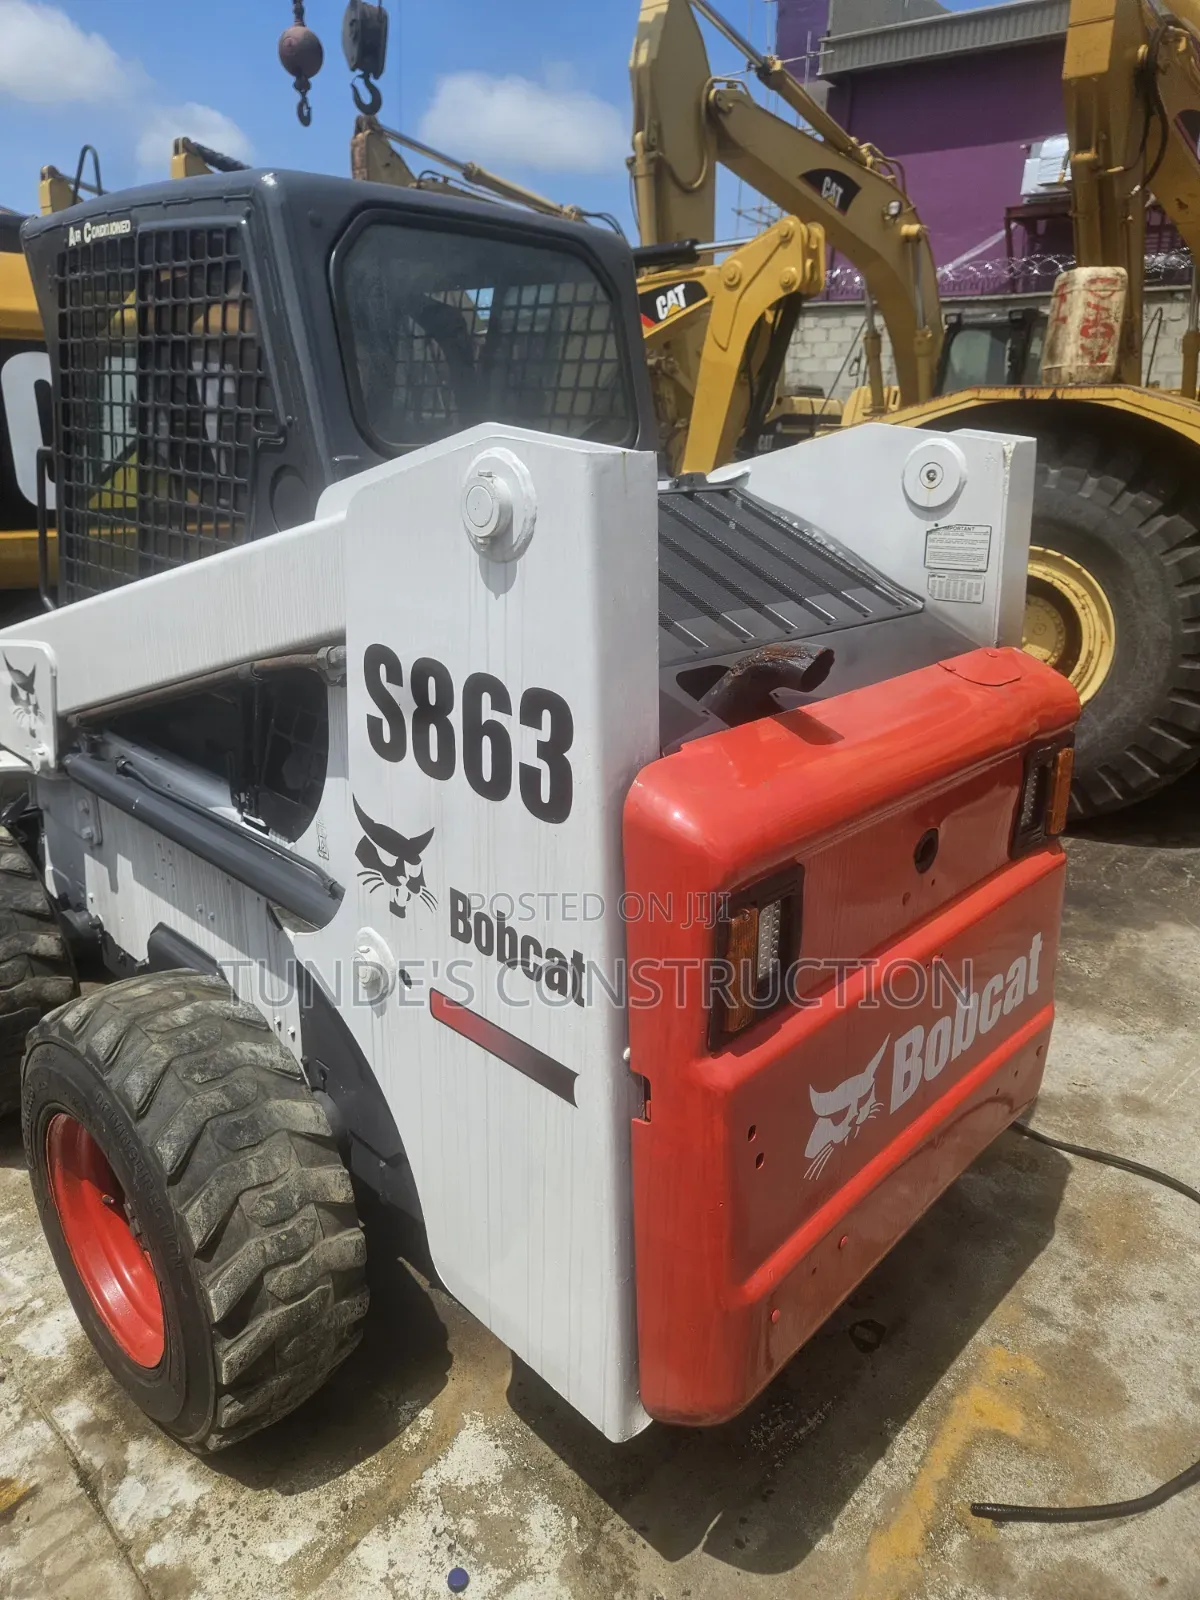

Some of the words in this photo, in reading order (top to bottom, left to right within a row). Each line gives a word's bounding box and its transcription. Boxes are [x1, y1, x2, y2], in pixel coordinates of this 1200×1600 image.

[821, 176, 844, 208] CAT
[656, 283, 686, 320] CAT
[363, 643, 574, 824] S863
[450, 887, 586, 1008] Bobcat
[890, 932, 1043, 1115] Bobcat
